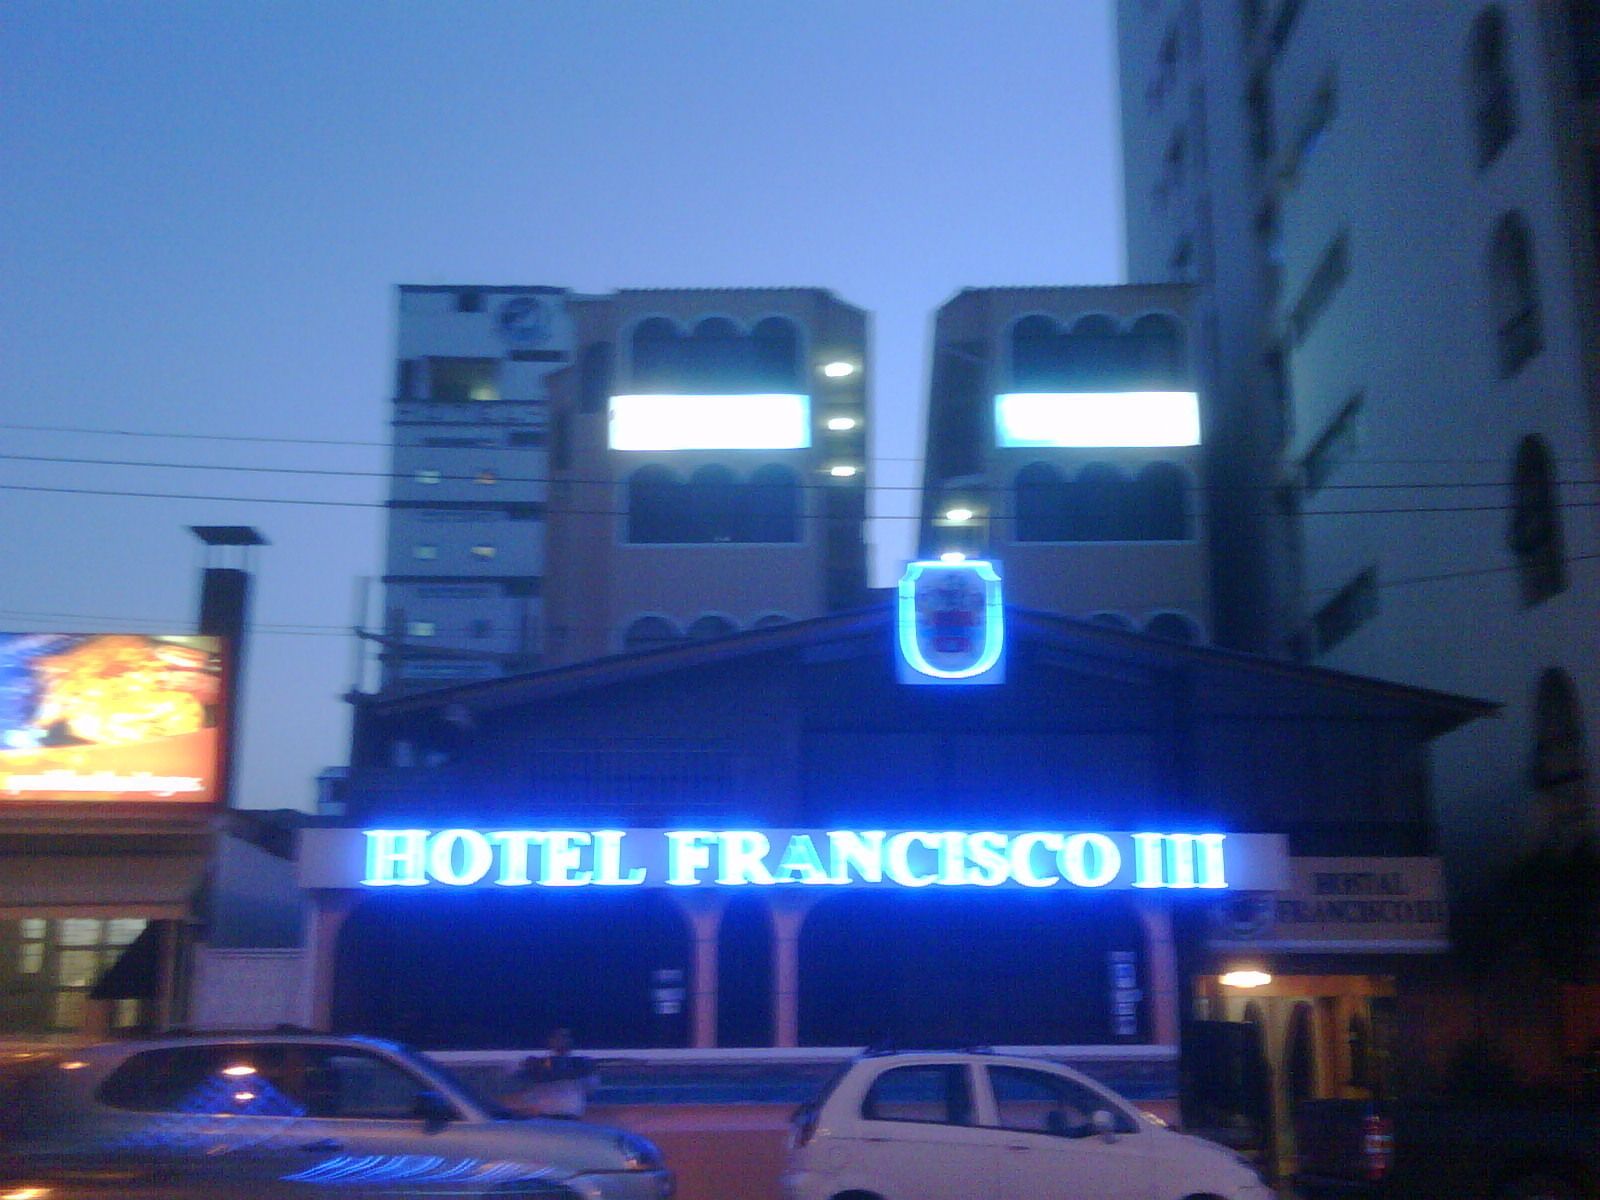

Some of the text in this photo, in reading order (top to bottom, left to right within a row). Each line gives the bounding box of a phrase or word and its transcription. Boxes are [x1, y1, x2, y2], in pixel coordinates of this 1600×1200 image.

[360, 829, 1229, 889] HOTEL FRANCISCO III
